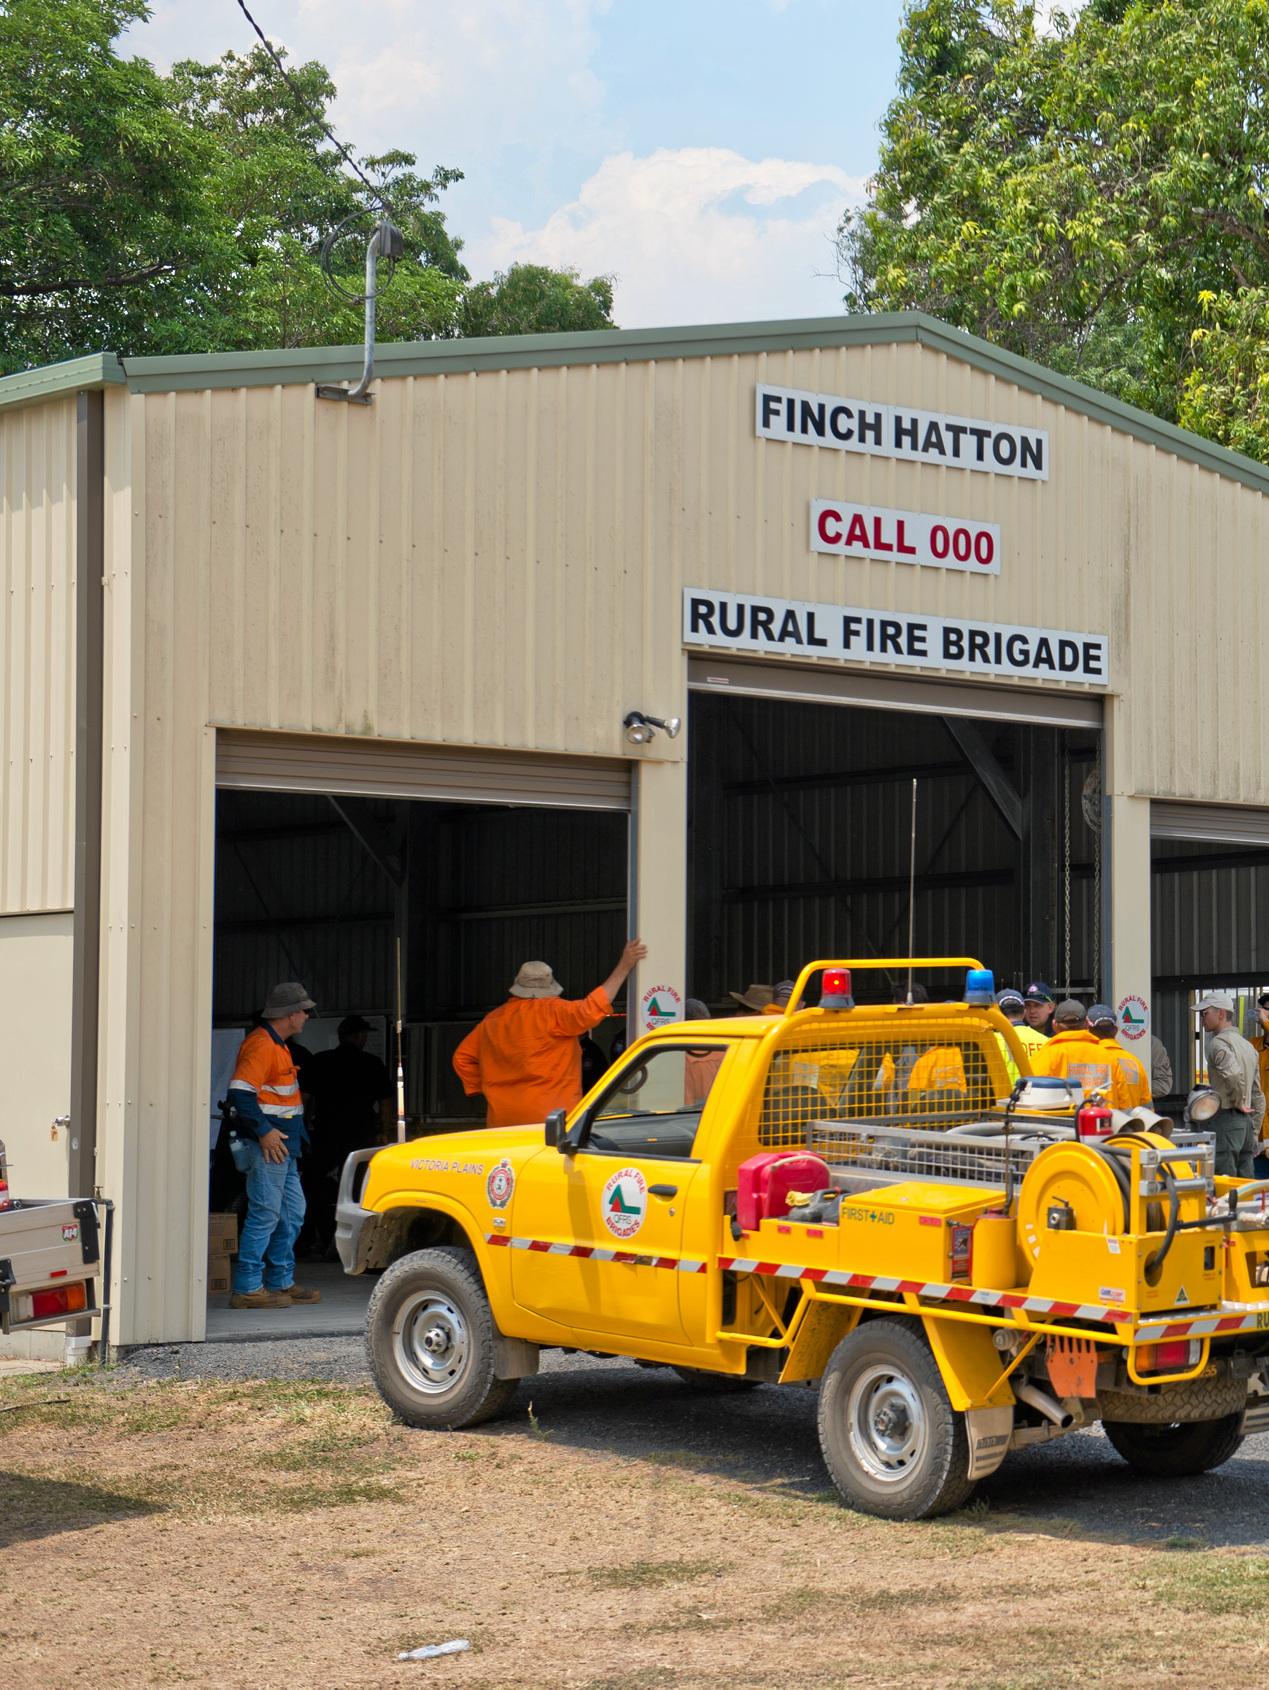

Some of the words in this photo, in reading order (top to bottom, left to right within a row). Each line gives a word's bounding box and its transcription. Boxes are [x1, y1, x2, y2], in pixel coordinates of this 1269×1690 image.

[762, 393, 883, 446] FINCH
[894, 414, 1044, 471] HATTON
[817, 509, 917, 555] CALL
[930, 524, 994, 565] 000
[690, 597, 828, 648] RURAL
[842, 615, 928, 657] FIRE
[942, 626, 1103, 675] BRIGADE
[1119, 995, 1136, 1011] RURAL
[1137, 996, 1148, 1011] FIRE
[410, 1160, 449, 1171] VICTORIA
[451, 1162, 484, 1175] PLAINS
[606, 1169, 633, 1191] RURAL
[634, 1172, 646, 1194] FIRE
[606, 1216, 640, 1237] BRIGADES
[841, 1207, 869, 1222] FIRST
[878, 1212, 896, 1225] AID
